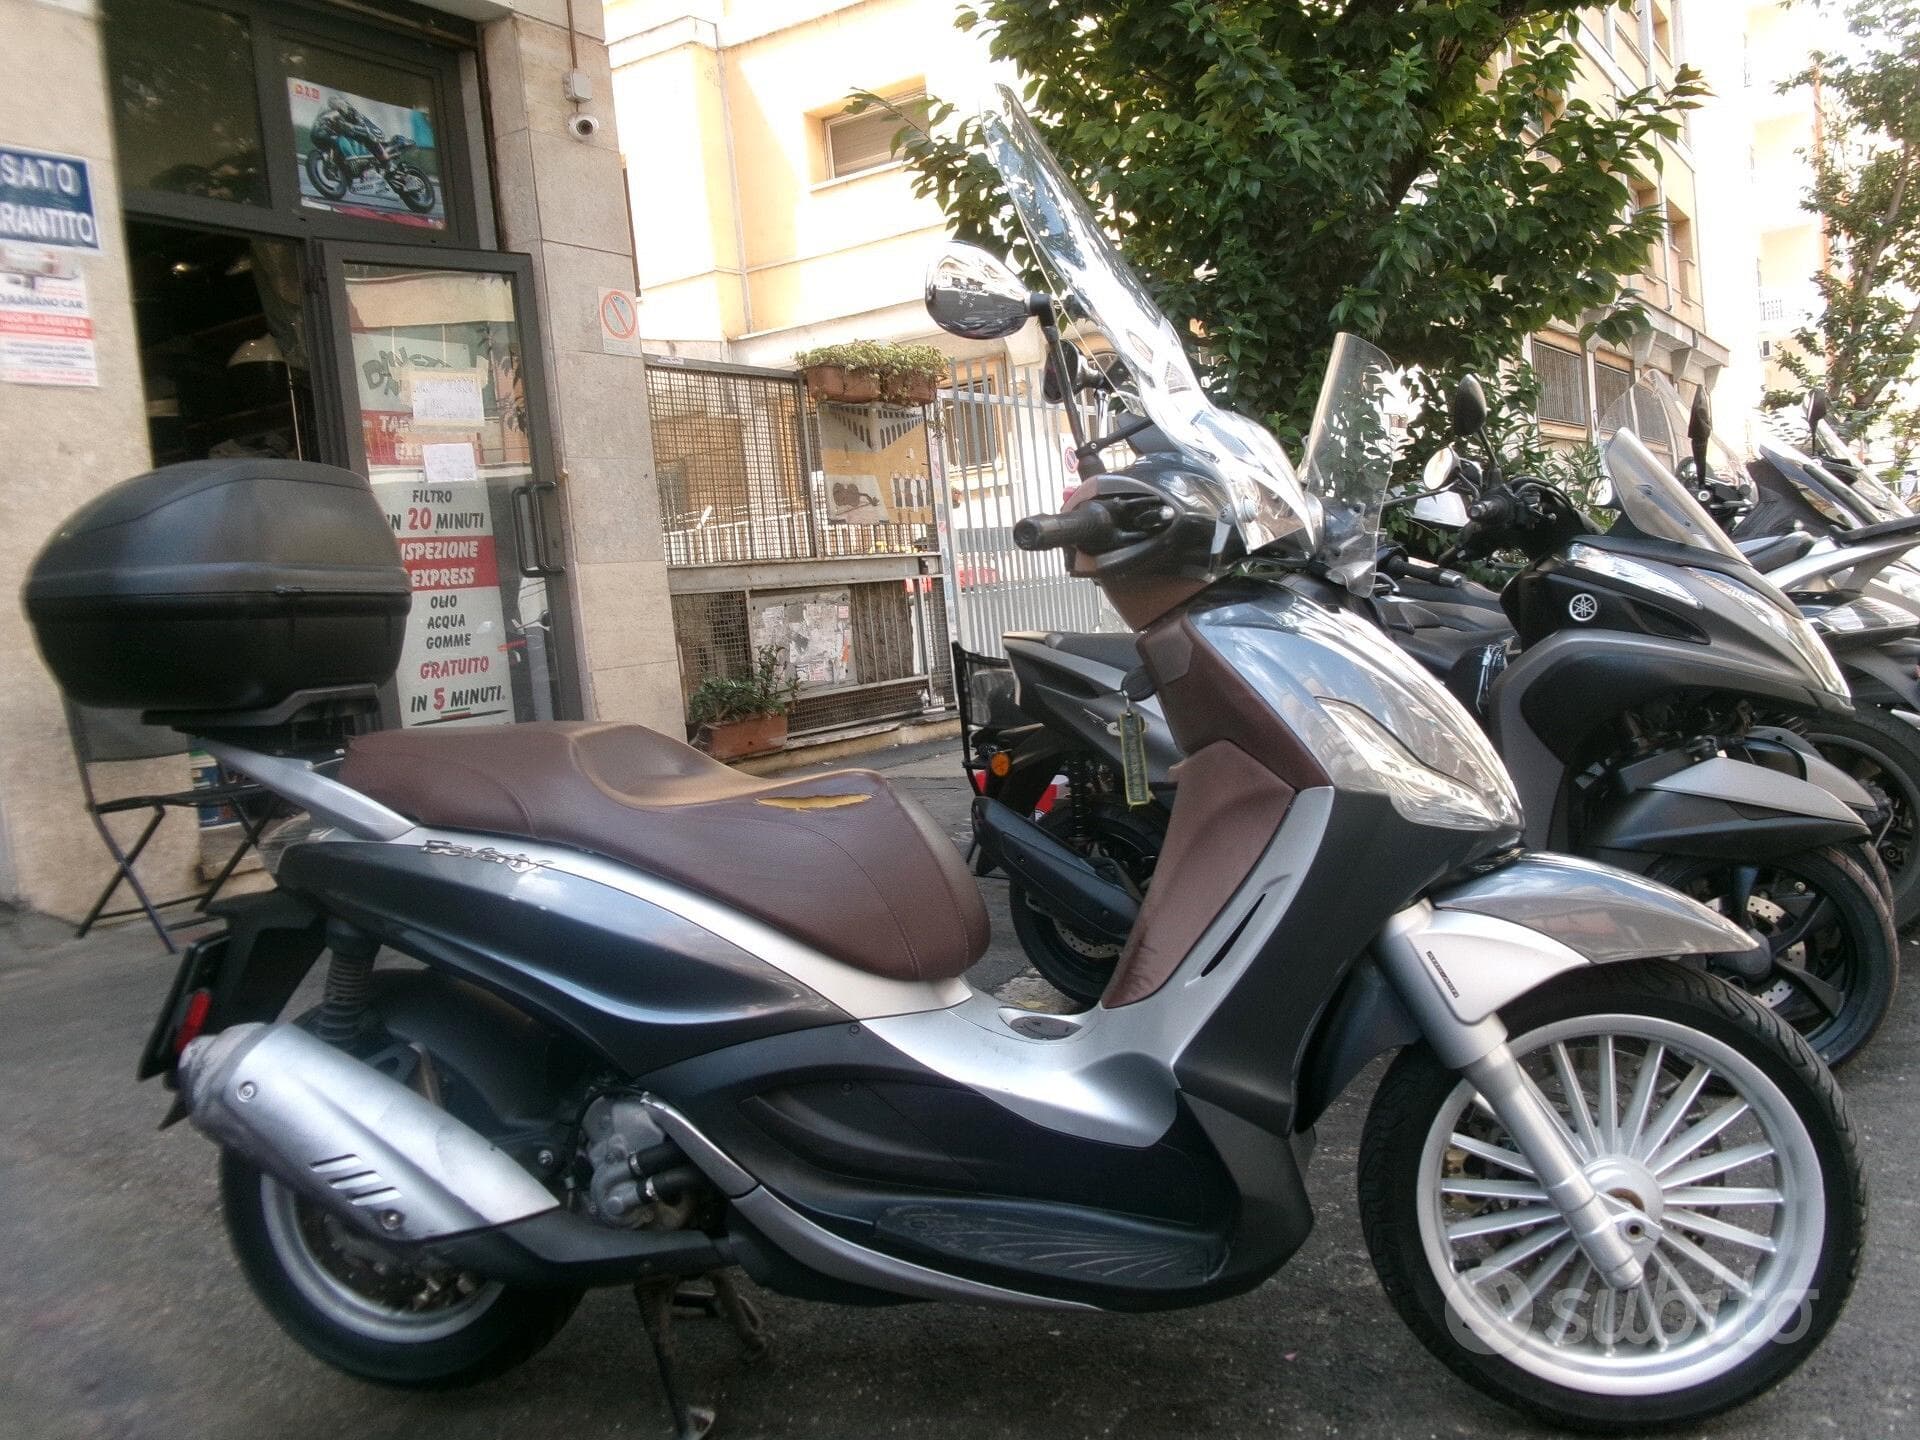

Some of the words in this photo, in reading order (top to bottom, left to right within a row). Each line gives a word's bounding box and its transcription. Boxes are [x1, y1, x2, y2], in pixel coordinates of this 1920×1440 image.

[0, 153, 77, 194] SATO
[0, 203, 93, 242] RANTITO
[412, 489, 453, 503] FILTRO
[408, 507, 432, 530] 20
[436, 512, 484, 529] MINUTI
[401, 540, 478, 561] ISPEZIONE
[411, 567, 475, 588] EXPRESS
[430, 595, 457, 609] OLIO
[427, 614, 465, 630] ACQUA
[426, 633, 471, 649] GOMME
[420, 655, 489, 680] GRATUITO
[410, 695, 428, 713] IN
[433, 687, 446, 711] 5
[450, 685, 502, 708] MINUTI
